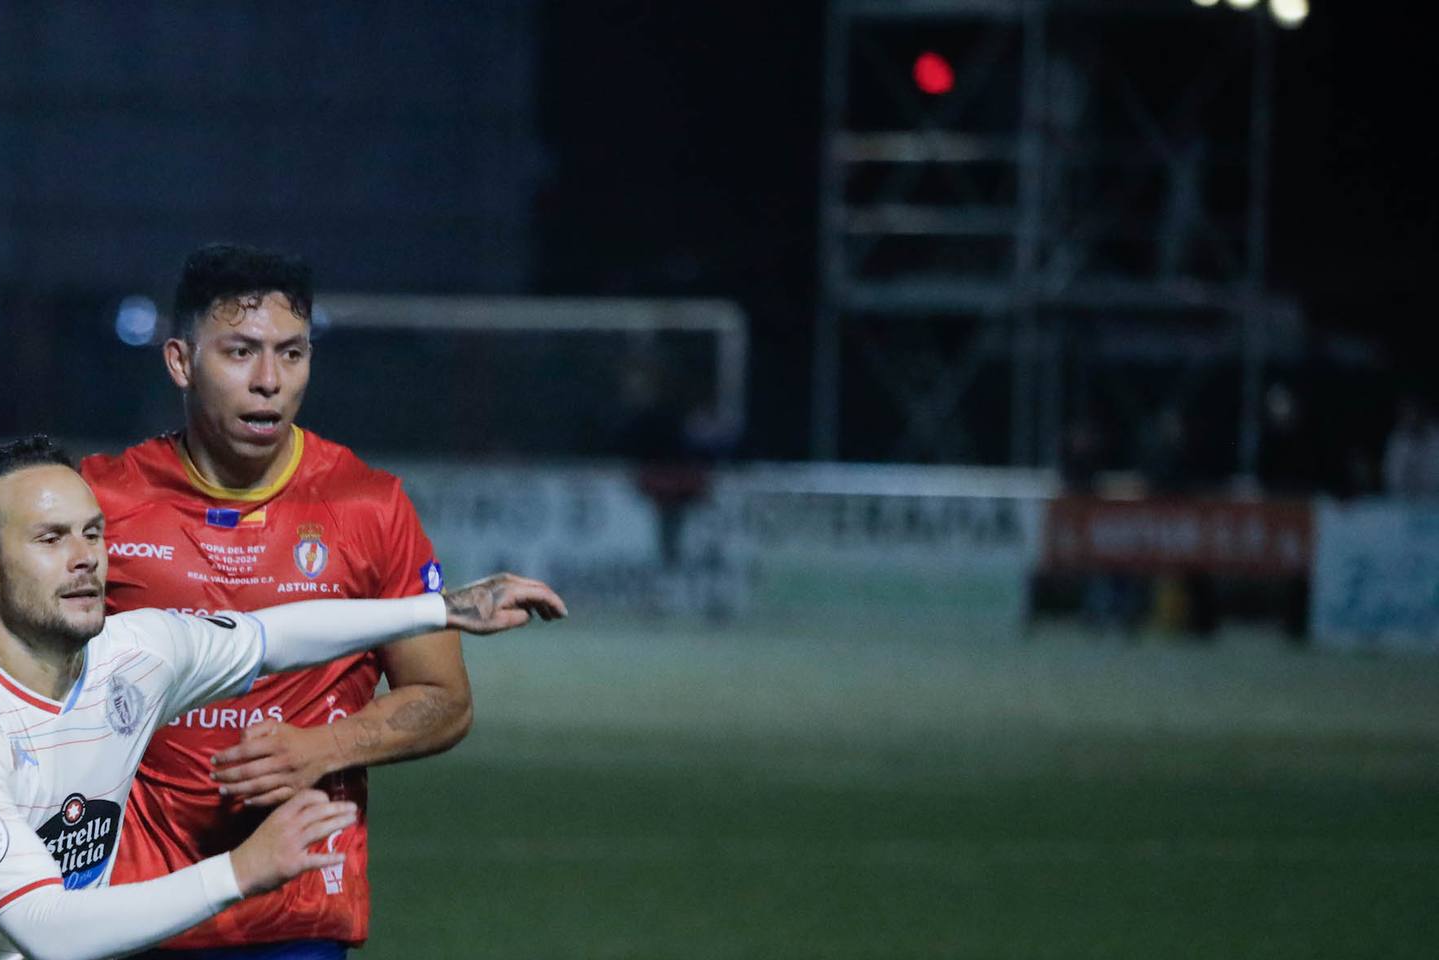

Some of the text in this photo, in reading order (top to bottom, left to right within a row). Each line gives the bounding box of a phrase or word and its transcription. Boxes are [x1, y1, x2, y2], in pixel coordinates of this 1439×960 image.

[200, 542, 266, 554] COPA DEL REY
[187, 571, 208, 581] REAL
[210, 575, 259, 585] VALLADOLID
[277, 582, 316, 593] ASTUR
[46, 817, 112, 854] strella
[61, 842, 105, 873] licia
